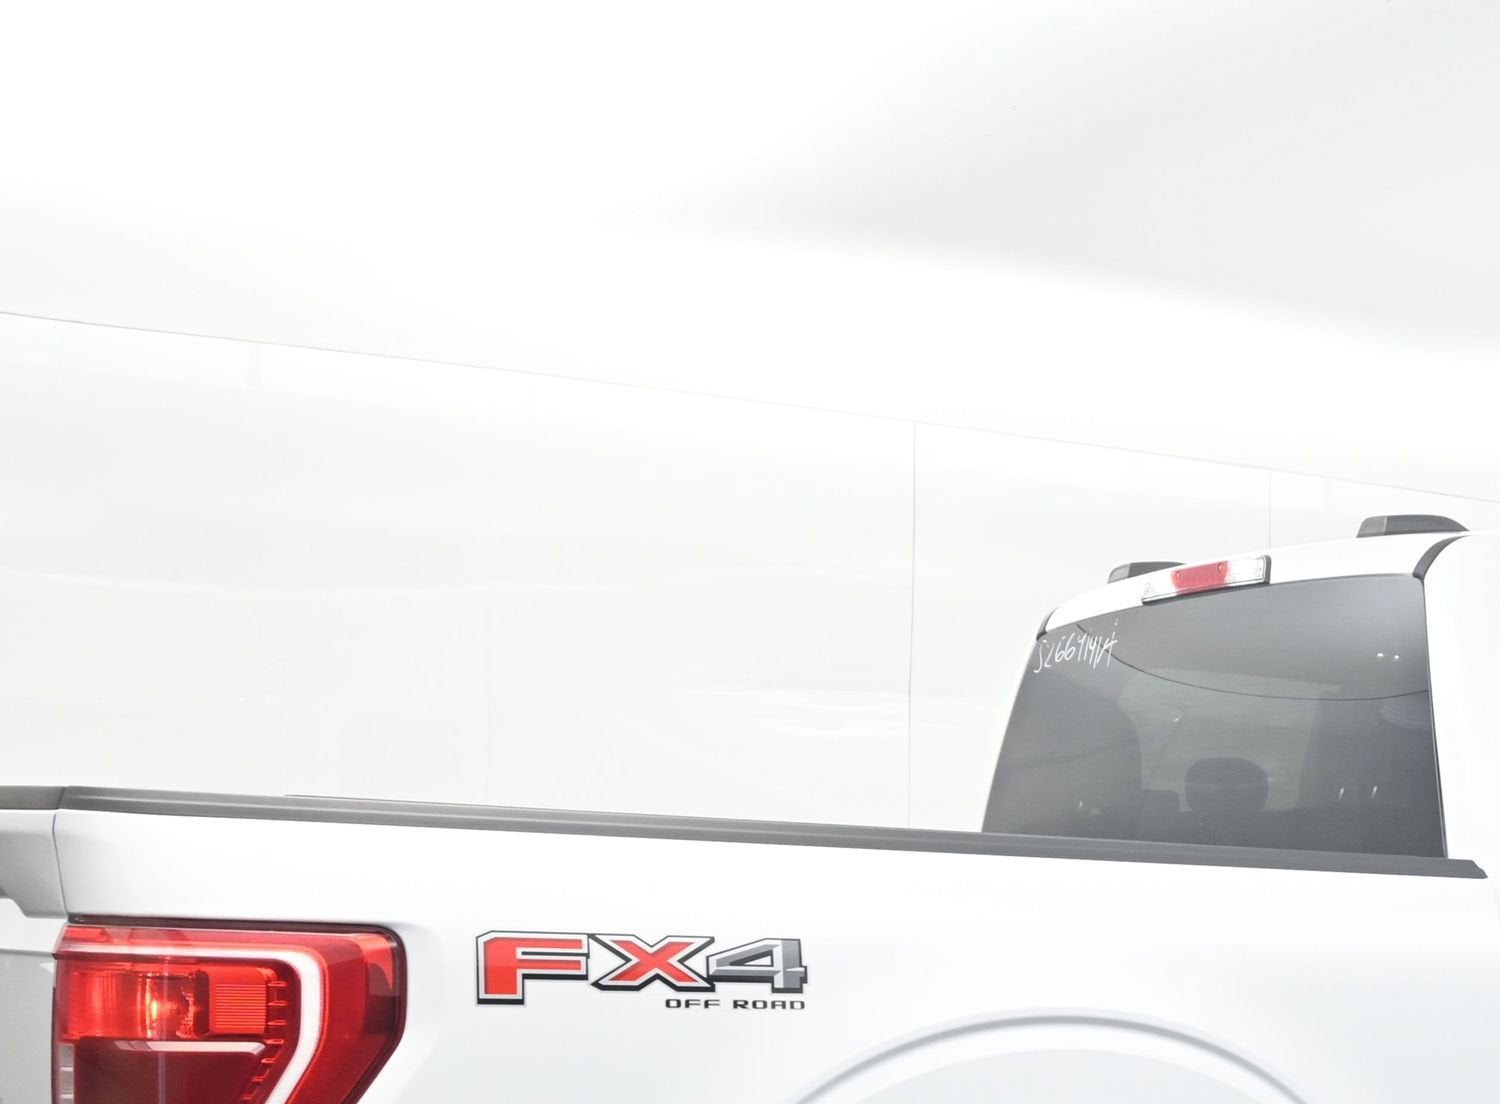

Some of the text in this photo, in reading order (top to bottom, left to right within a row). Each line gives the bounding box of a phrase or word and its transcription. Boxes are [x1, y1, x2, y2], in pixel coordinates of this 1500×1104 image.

[476, 930, 808, 1005] FX4
[665, 998, 806, 1010] OFF ROAD
